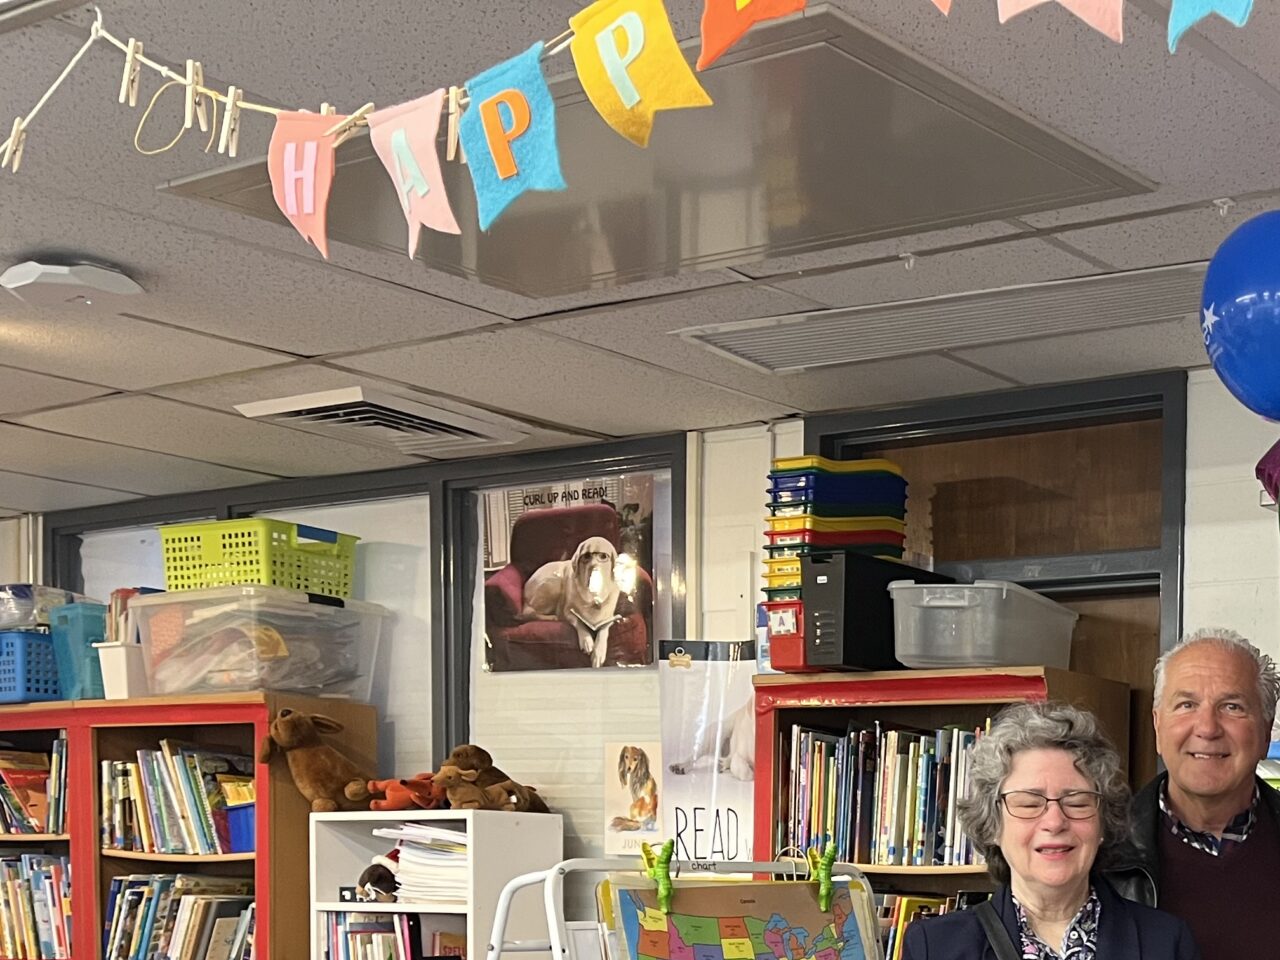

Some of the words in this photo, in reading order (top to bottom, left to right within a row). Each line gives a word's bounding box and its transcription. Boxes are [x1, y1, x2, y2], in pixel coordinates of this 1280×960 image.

[523, 494, 546, 506] CURL
[547, 492, 559, 503] UP
[561, 489, 579, 501] AND
[581, 486, 607, 499] READ!
[674, 806, 739, 861] READ
[622, 838, 642, 850] JUN
[691, 860, 717, 871] chart
